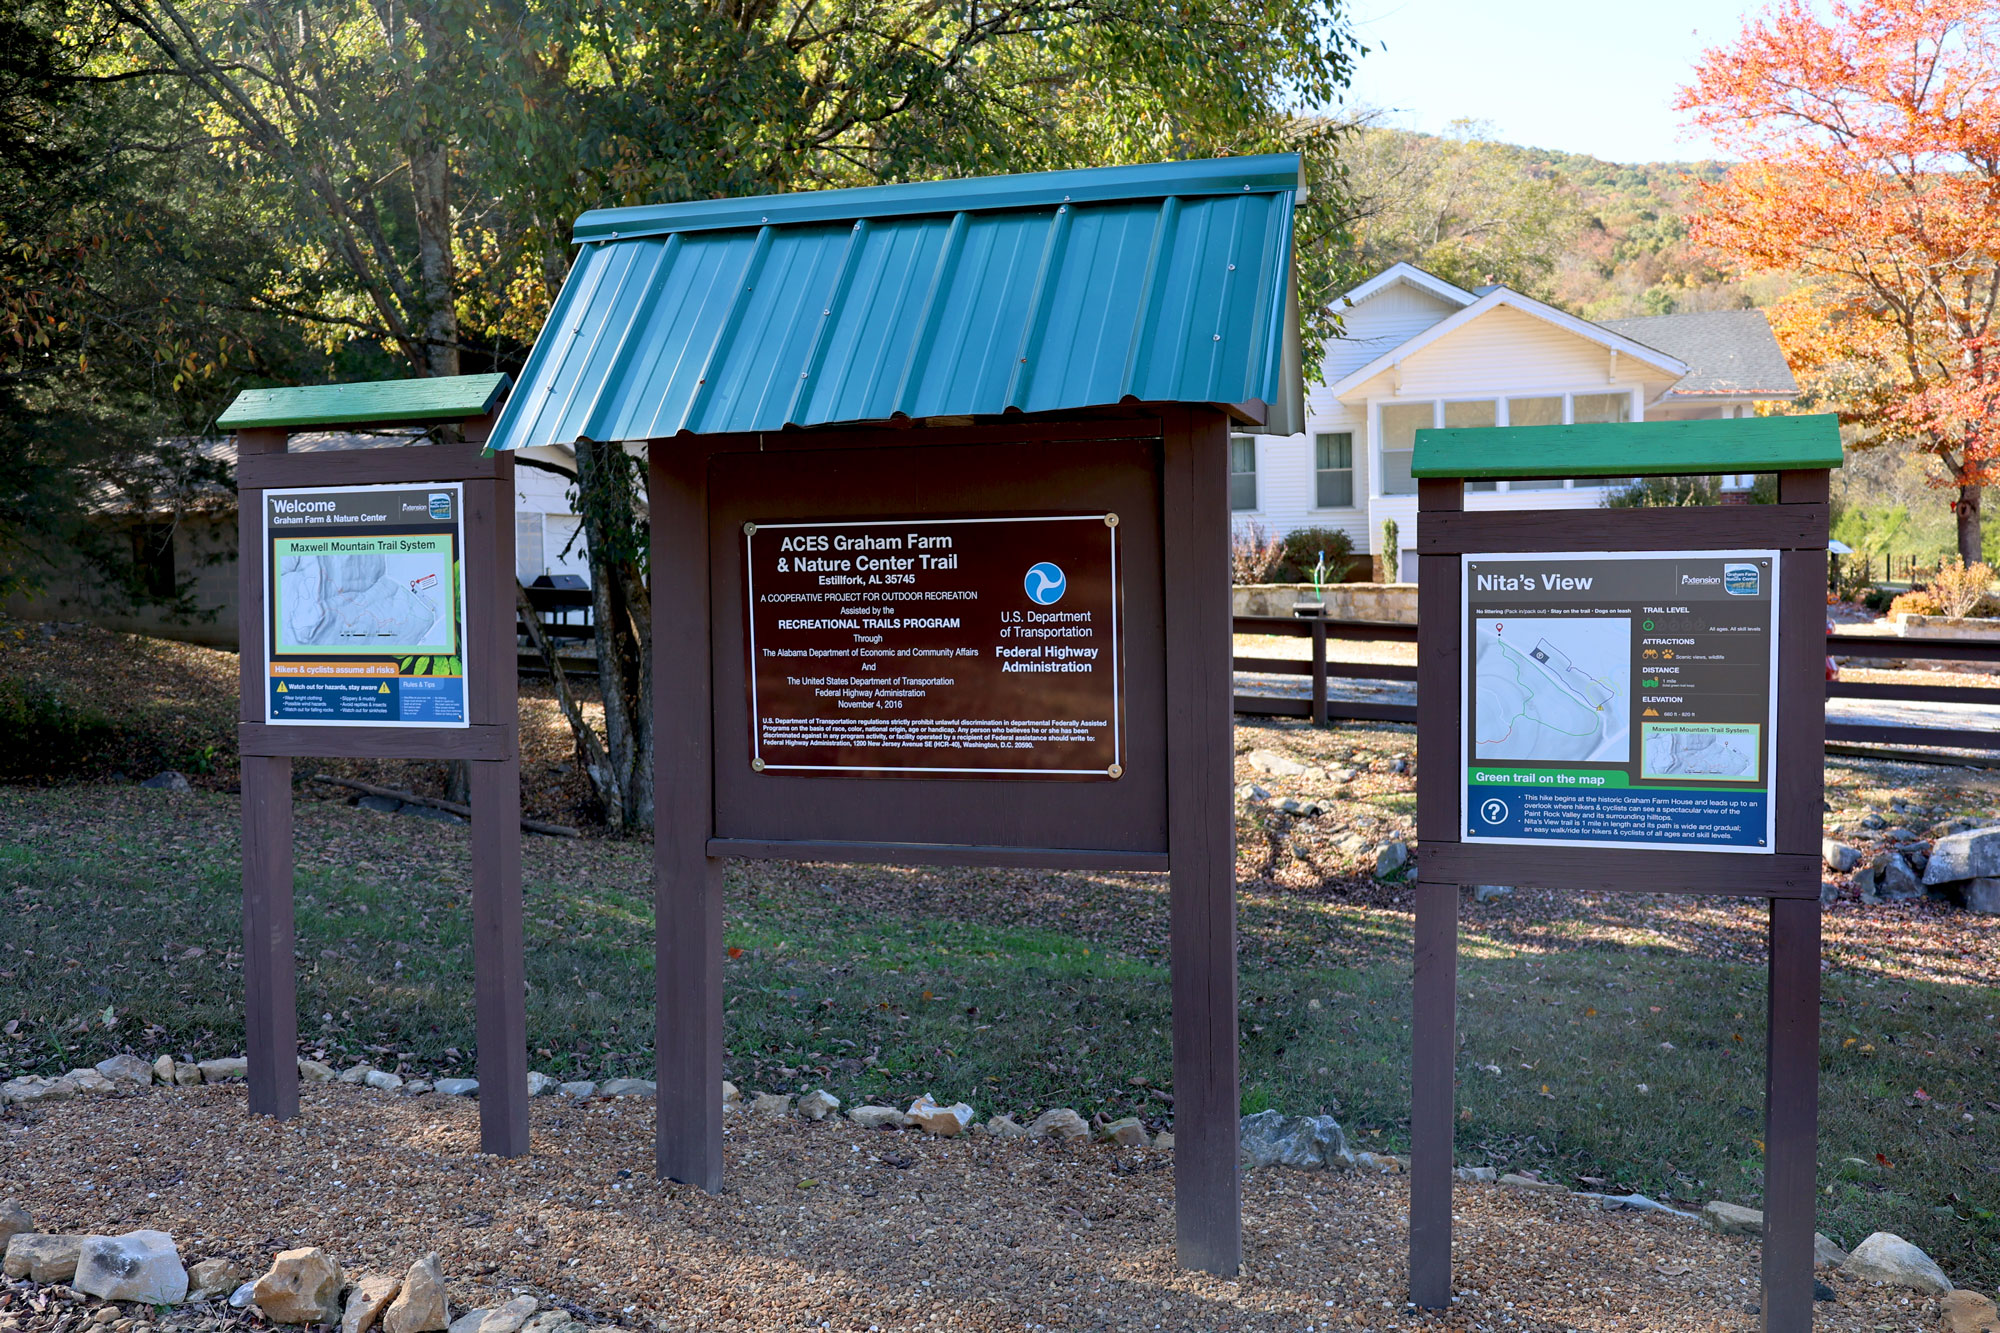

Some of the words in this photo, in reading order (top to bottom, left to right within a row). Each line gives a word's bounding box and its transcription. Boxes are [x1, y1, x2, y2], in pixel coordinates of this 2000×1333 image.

[274, 499, 336, 513] Welcome
[273, 516, 303, 524] Graham
[304, 515, 324, 523] Farm
[325, 514, 332, 523] &
[333, 514, 359, 522] Nature
[360, 513, 387, 522] Center
[290, 542, 328, 552] Maxwell
[331, 541, 374, 551] Mountain
[377, 540, 397, 550] Trail
[400, 540, 435, 551] System
[780, 535, 829, 551] ACES
[833, 534, 901, 550] Graham
[907, 533, 952, 548] Farm
[777, 557, 789, 572] &
[794, 556, 851, 572] Nature
[855, 555, 914, 570] Center
[918, 553, 957, 569] Trail
[818, 575, 866, 585] Estillfork,
[868, 574, 882, 584] AL
[884, 573, 915, 584] 35745
[1477, 574, 1535, 590] Nita's
[1541, 573, 1593, 590] View
[760, 593, 766, 602] A
[767, 593, 822, 602] COOPERATIVE
[824, 592, 861, 601] PROJECT
[862, 592, 880, 601] FOR
[881, 591, 923, 601] OUTDOOR
[924, 591, 977, 600] RECREATION
[840, 606, 870, 615] Assisted
[871, 606, 881, 616] by
[882, 606, 894, 614] the
[1001, 611, 1024, 622] U.S.
[1027, 611, 1091, 623] Department
[778, 618, 860, 629] RECREATIONAL
[862, 618, 901, 628] TRAILS
[903, 617, 960, 628] PROGRAM
[1000, 626, 1011, 637] of
[1013, 626, 1092, 639] Transportation
[853, 633, 883, 644] Through
[762, 648, 776, 657] The
[777, 648, 807, 657] Alabama
[808, 648, 850, 658] Department
[850, 648, 858, 656] of
[860, 648, 895, 656] Economic
[896, 648, 911, 656] and
[912, 647, 954, 658] Community
[955, 647, 979, 656] Affairs
[995, 646, 1041, 657] Federal
[1044, 646, 1098, 659] Highway
[274, 665, 298, 673] Hikers
[299, 665, 305, 673] &
[306, 665, 334, 674] cyclists
[365, 665, 375, 673] all
[376, 665, 395, 673] risks
[861, 662, 876, 671] And
[1001, 661, 1092, 672] Administration
[786, 676, 800, 685] The
[801, 676, 825, 685] United
[826, 676, 849, 685] States
[850, 676, 891, 686] Department
[892, 676, 900, 685] of
[901, 676, 954, 686] Transportation
[815, 688, 841, 697] Federal
[842, 688, 873, 698] Highway
[874, 688, 925, 697] Administration
[838, 700, 874, 708] November
[875, 699, 883, 709] 4,
[884, 699, 902, 708] 2016
[1475, 772, 1510, 782] Green
[1513, 773, 1535, 782] trail
[1538, 775, 1553, 783] on
[1556, 773, 1575, 783] the
[1578, 776, 1605, 786] map
[1554, 795, 1576, 803] begins
[1561, 811, 1581, 819] Valley
[1605, 813, 1645, 821] surrounding
[1646, 813, 1672, 821] hilltops.
